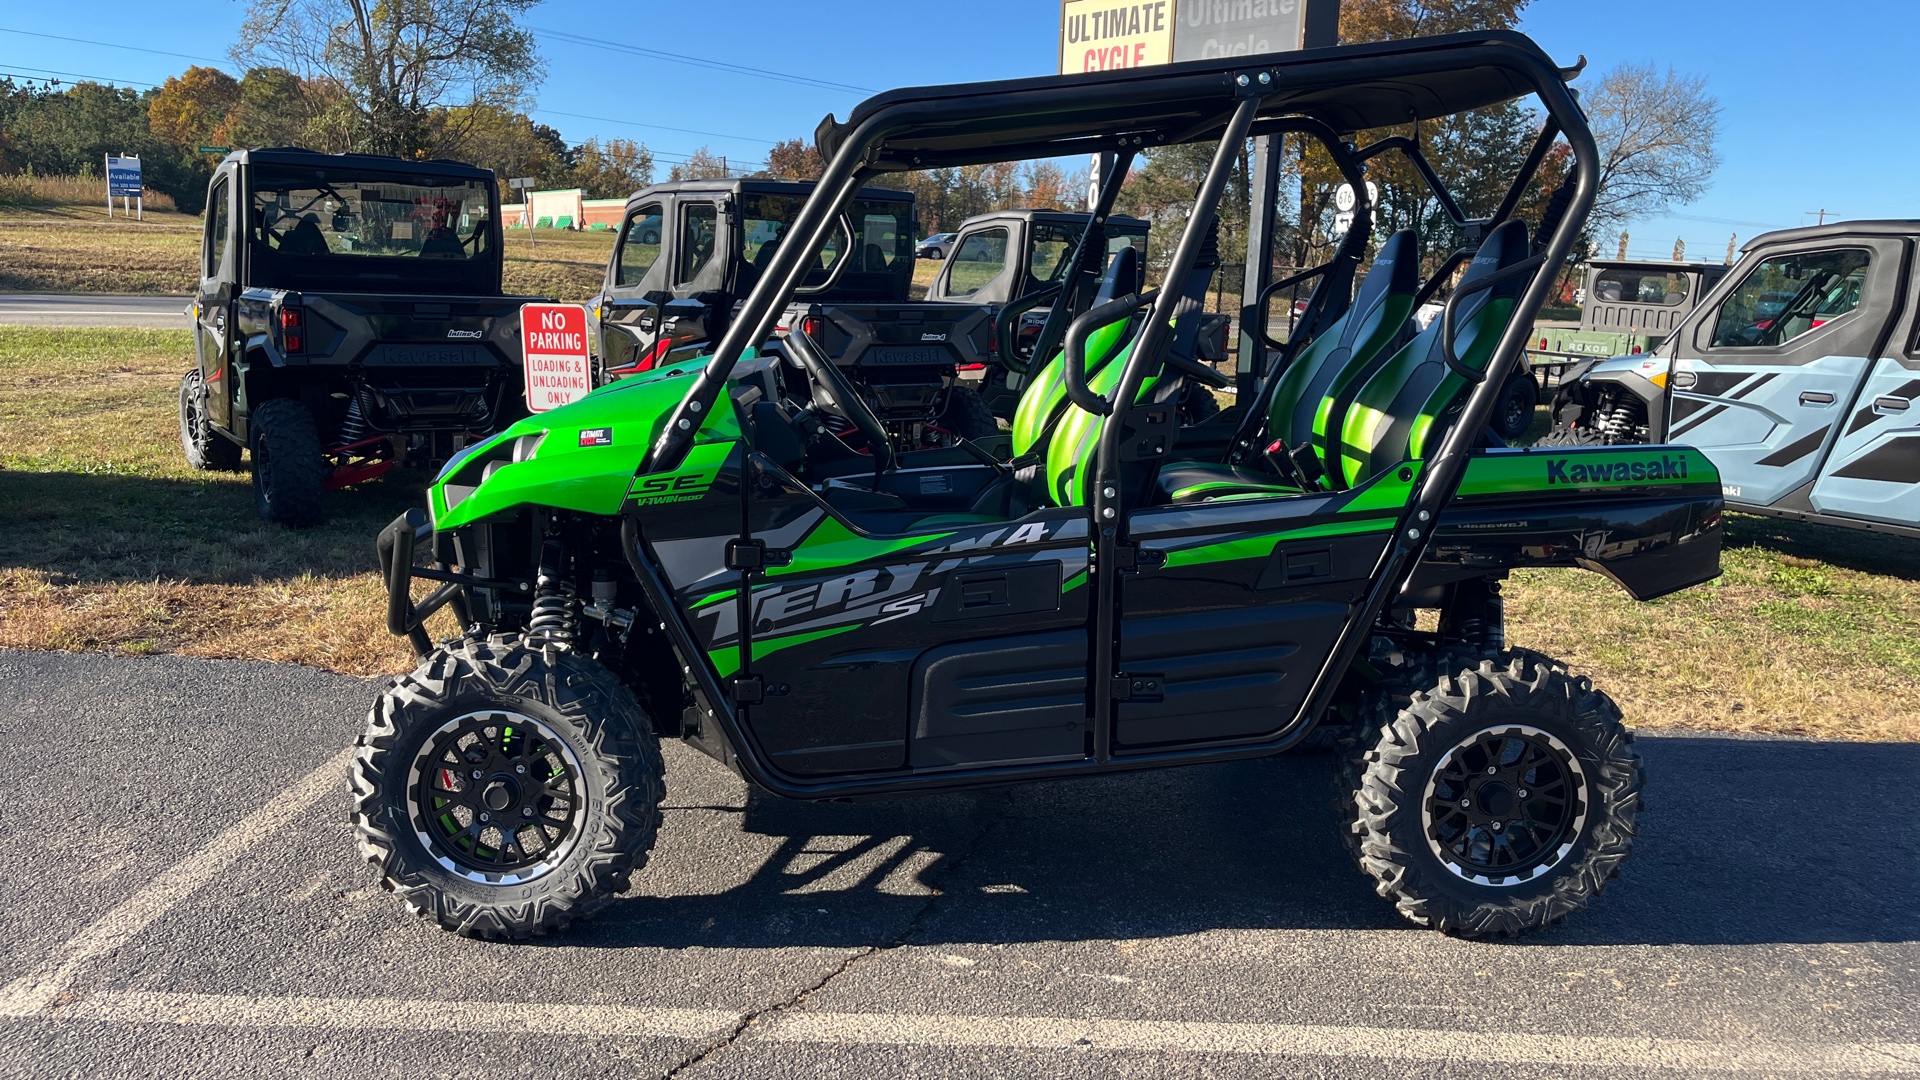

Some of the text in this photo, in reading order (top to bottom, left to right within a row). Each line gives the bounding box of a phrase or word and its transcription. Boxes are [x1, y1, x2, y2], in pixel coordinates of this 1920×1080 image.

[1187, 0, 1295, 27] Ultimate
[1068, 1, 1165, 44] ULTIMATE
[110, 172, 140, 180] Available
[1339, 191, 1352, 205] 676
[541, 312, 566, 330] NO
[530, 332, 581, 350] PARKING
[1568, 343, 1608, 354] ROXOR
[383, 347, 480, 364] Kawasaki
[874, 347, 943, 364] Kawasaki
[532, 359, 582, 373] LOADING &
[533, 375, 584, 389] UNLOADING
[547, 391, 571, 404] ONLY
[1546, 454, 1688, 485] Kawasaki
[630, 473, 704, 495] SE
